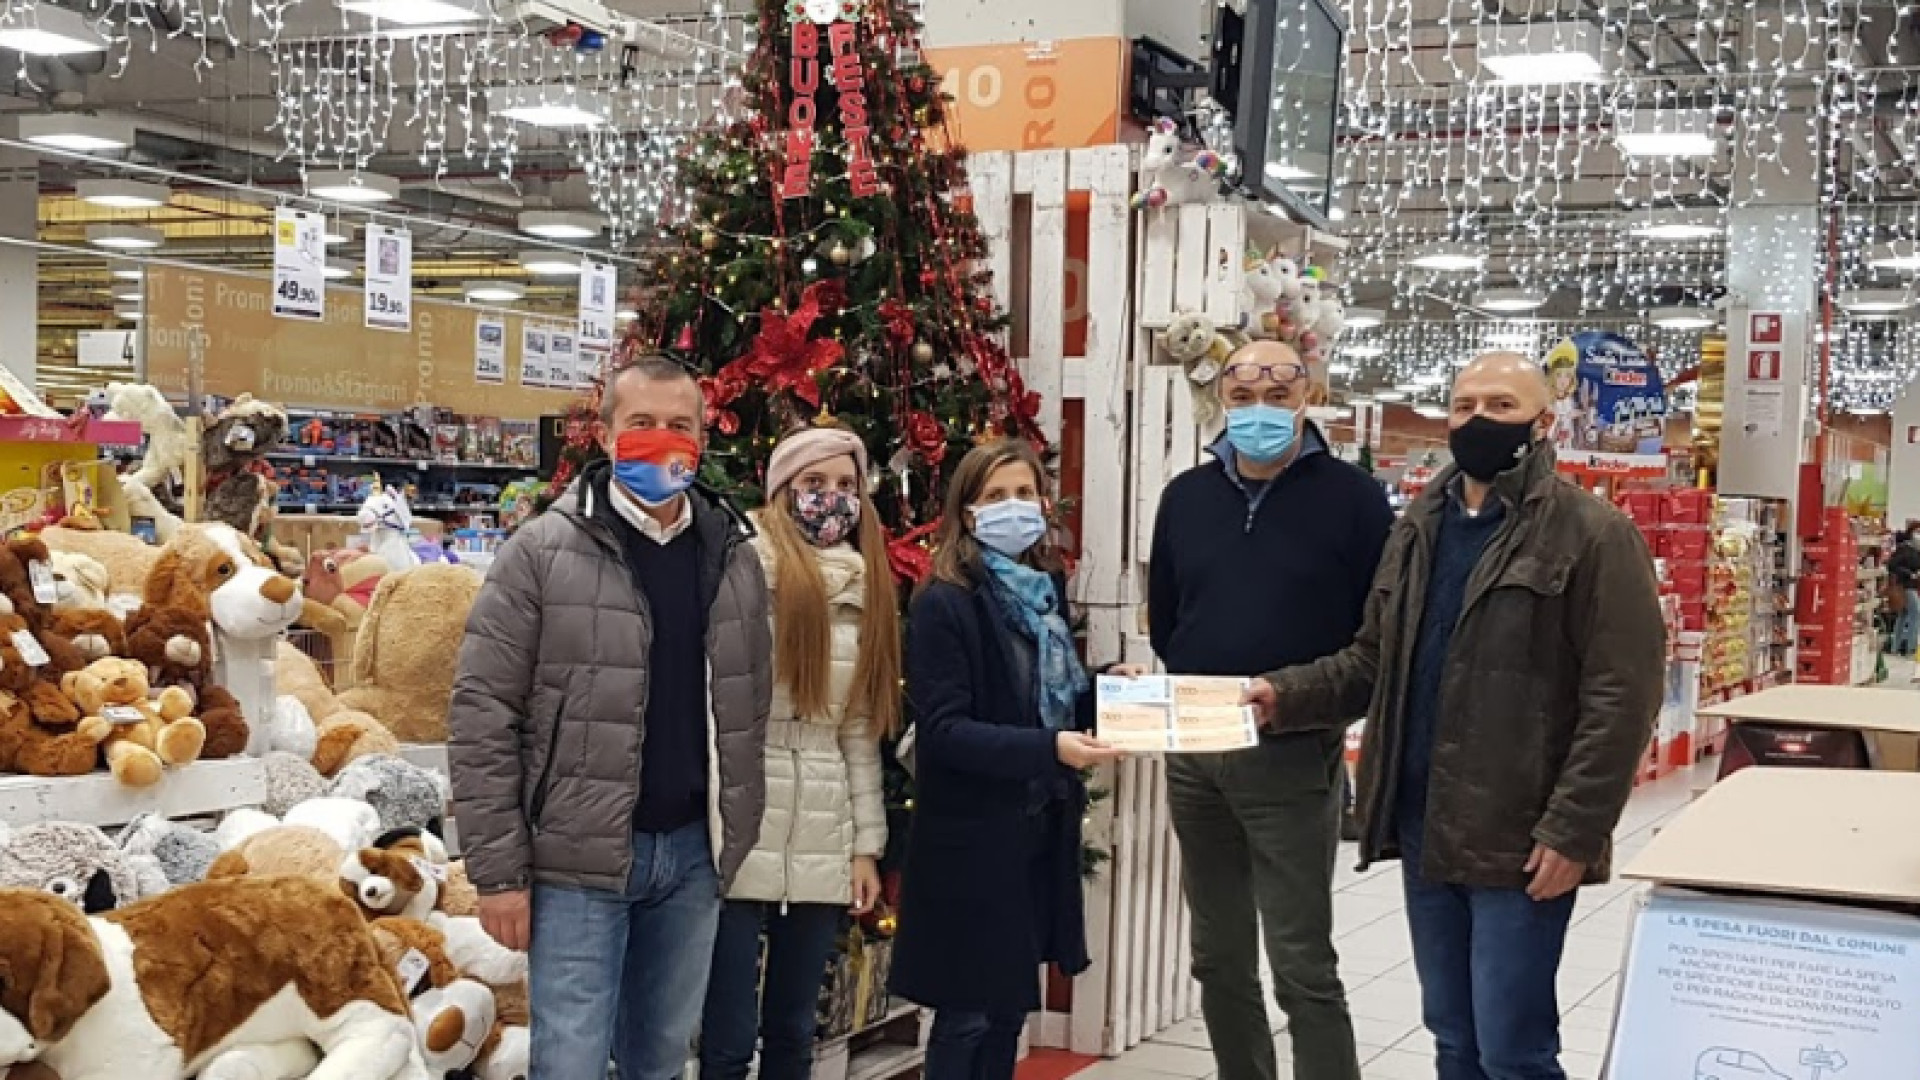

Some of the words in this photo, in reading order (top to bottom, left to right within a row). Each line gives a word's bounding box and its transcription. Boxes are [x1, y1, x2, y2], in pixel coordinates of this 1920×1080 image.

[1668, 914, 1688, 926] LA
[1693, 917, 1741, 933] SPESA
[1747, 925, 1794, 940] FUORI
[1799, 932, 1830, 945] DAL
[1836, 937, 1906, 956] COMUNE
